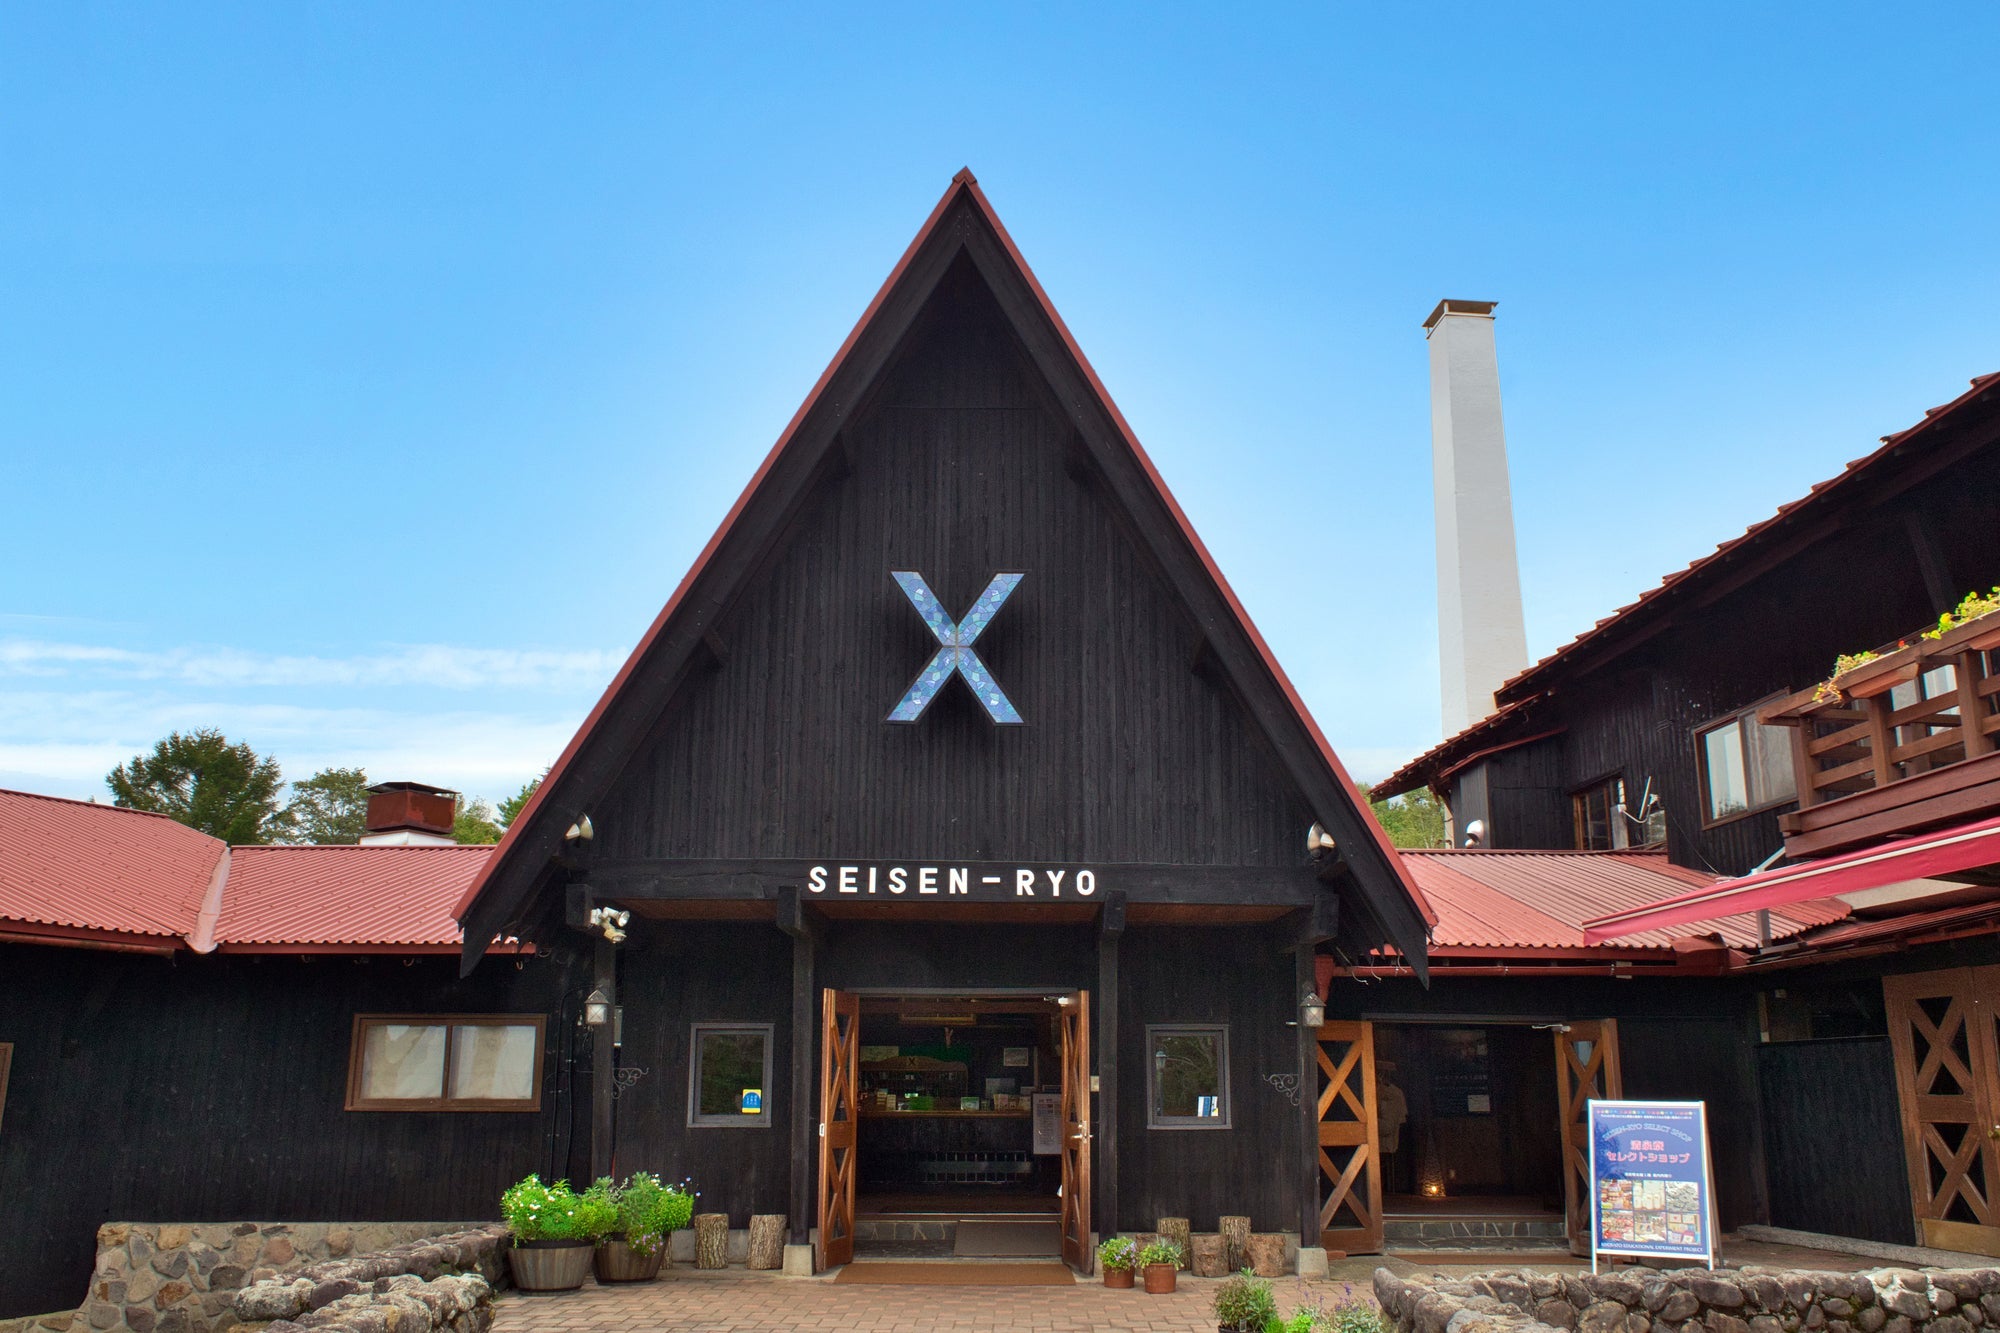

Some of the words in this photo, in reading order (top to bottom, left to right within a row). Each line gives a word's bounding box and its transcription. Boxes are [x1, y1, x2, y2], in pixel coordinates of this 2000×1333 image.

[1671, 1128, 1693, 1142] SHOP
[1606, 1151, 1691, 1164] セレクトショップ
